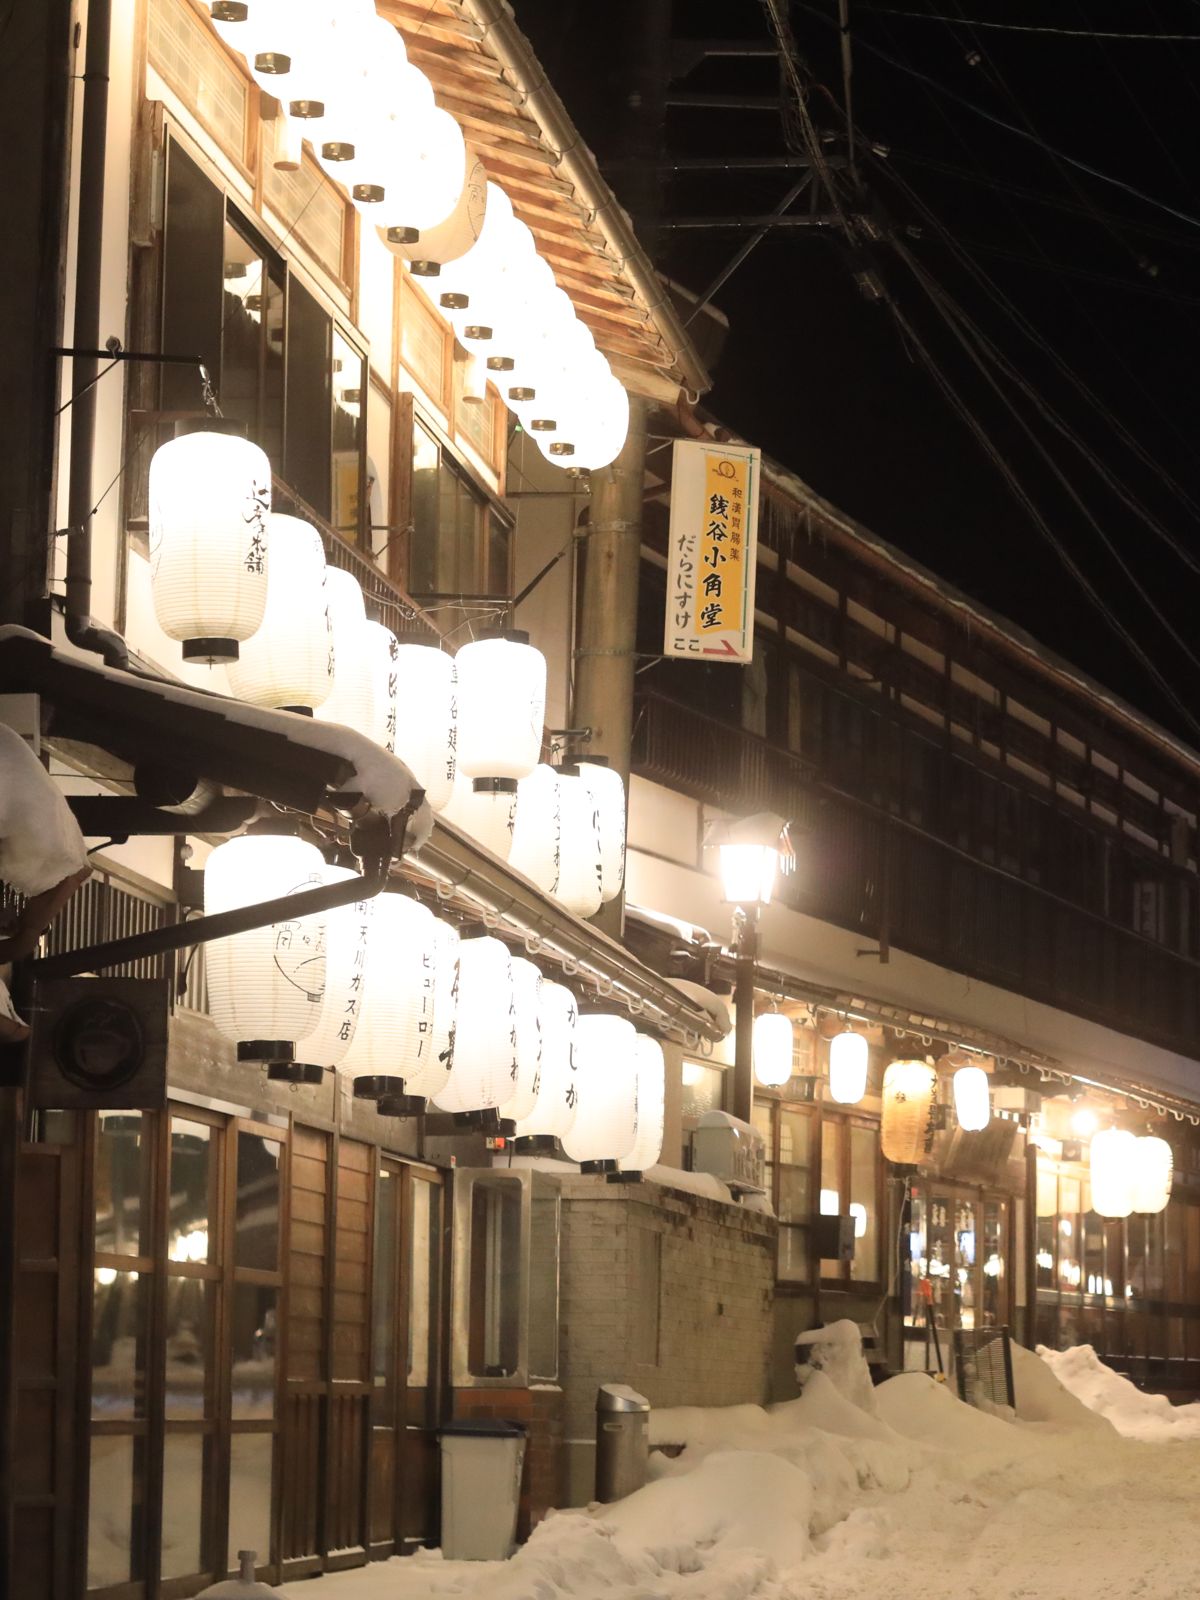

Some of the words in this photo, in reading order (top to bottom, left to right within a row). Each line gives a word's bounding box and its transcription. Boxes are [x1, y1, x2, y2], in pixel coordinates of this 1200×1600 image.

[700, 493, 729, 628] 銭谷小角堂
[729, 487, 743, 562] 和漢胃腸薬
[674, 534, 697, 629] だらにすけ
[674, 637, 700, 651] ここ
